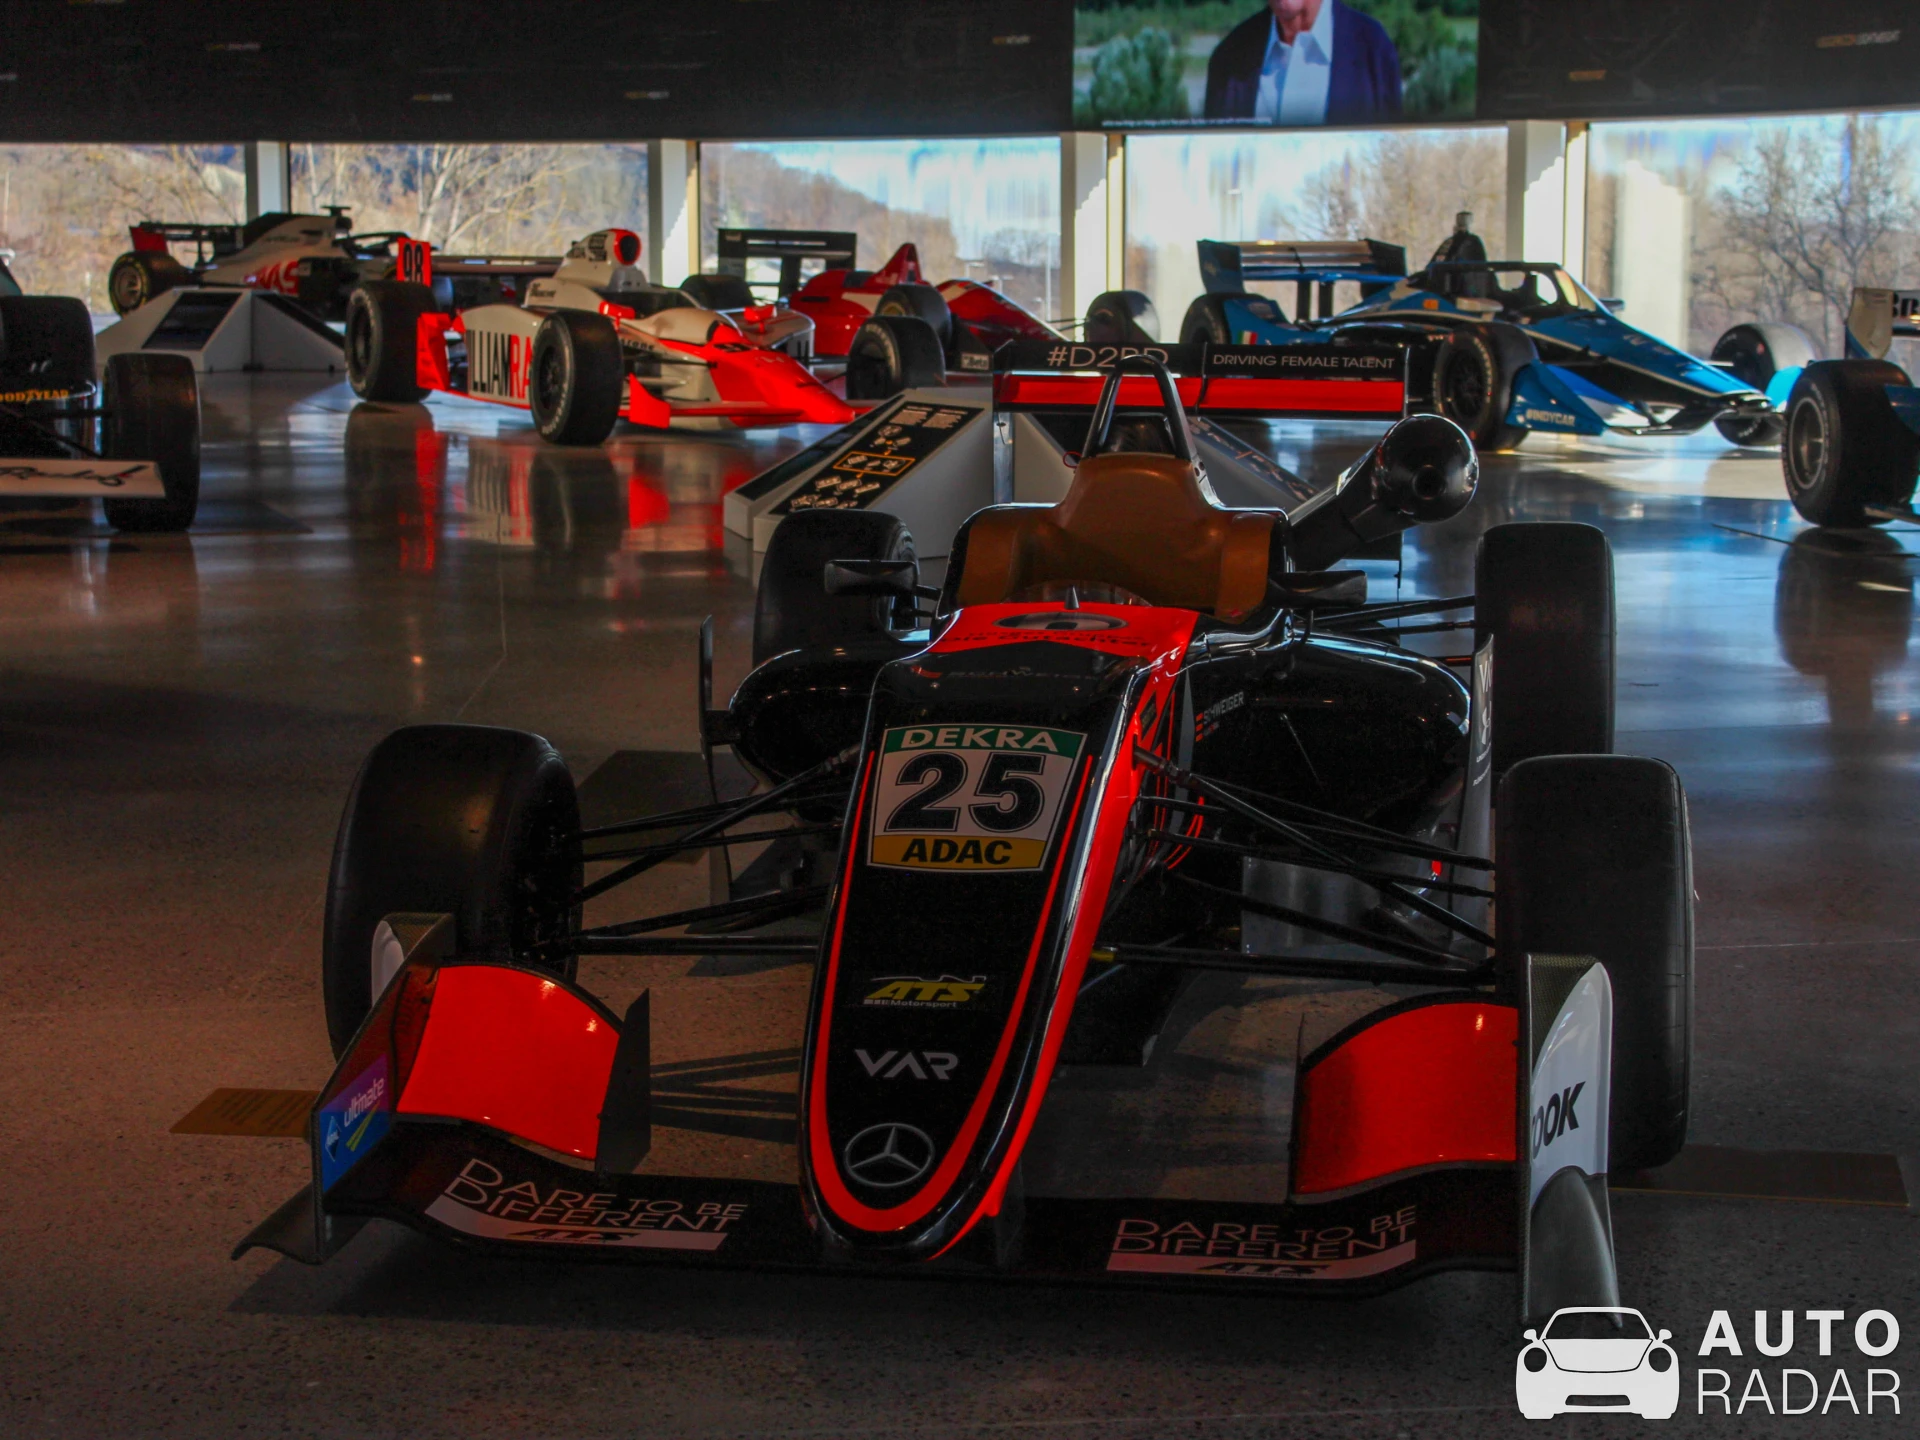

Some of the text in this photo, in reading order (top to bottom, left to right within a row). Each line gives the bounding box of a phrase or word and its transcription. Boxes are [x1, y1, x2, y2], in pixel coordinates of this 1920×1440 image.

[1213, 353, 1395, 369] DRIVING FEMALE TALENT
[900, 727, 1059, 750] DEKRA
[885, 751, 1047, 833] 25
[902, 838, 1014, 865] ADAC
[865, 980, 985, 1001] ATS
[854, 1049, 959, 1080] VAR
[344, 1078, 385, 1128] ultimate
[1532, 1081, 1586, 1159] OOK
[444, 1176, 740, 1232] DIFFERENT
[460, 1158, 748, 1216] DARE TO BE
[1111, 1221, 1417, 1260] DIFFERENT
[1116, 1205, 1417, 1243] DARE TO BE
